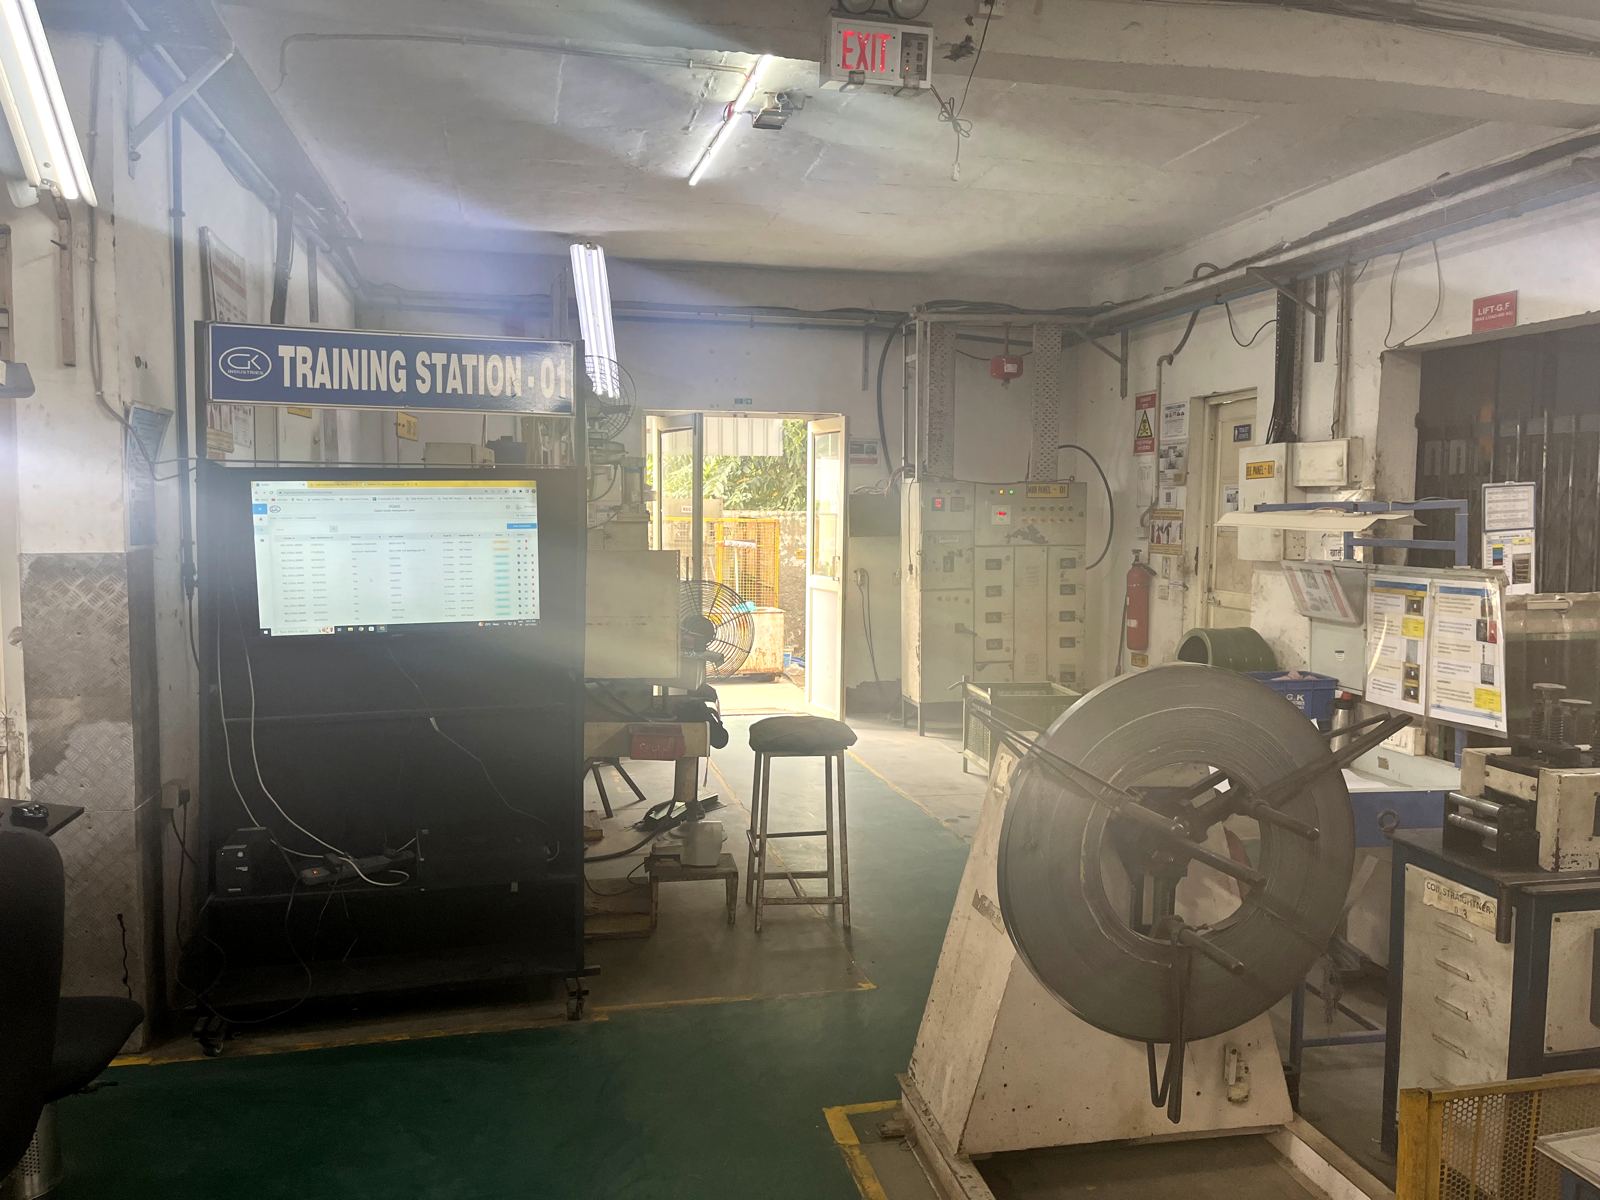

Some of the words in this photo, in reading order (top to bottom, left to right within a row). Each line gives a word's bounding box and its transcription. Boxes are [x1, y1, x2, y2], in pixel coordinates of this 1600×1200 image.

[842, 29, 892, 73] EXIT
[227, 353, 261, 370] GK
[278, 345, 407, 394] TRAINING
[415, 352, 522, 398] STATION
[540, 358, 567, 400] 01
